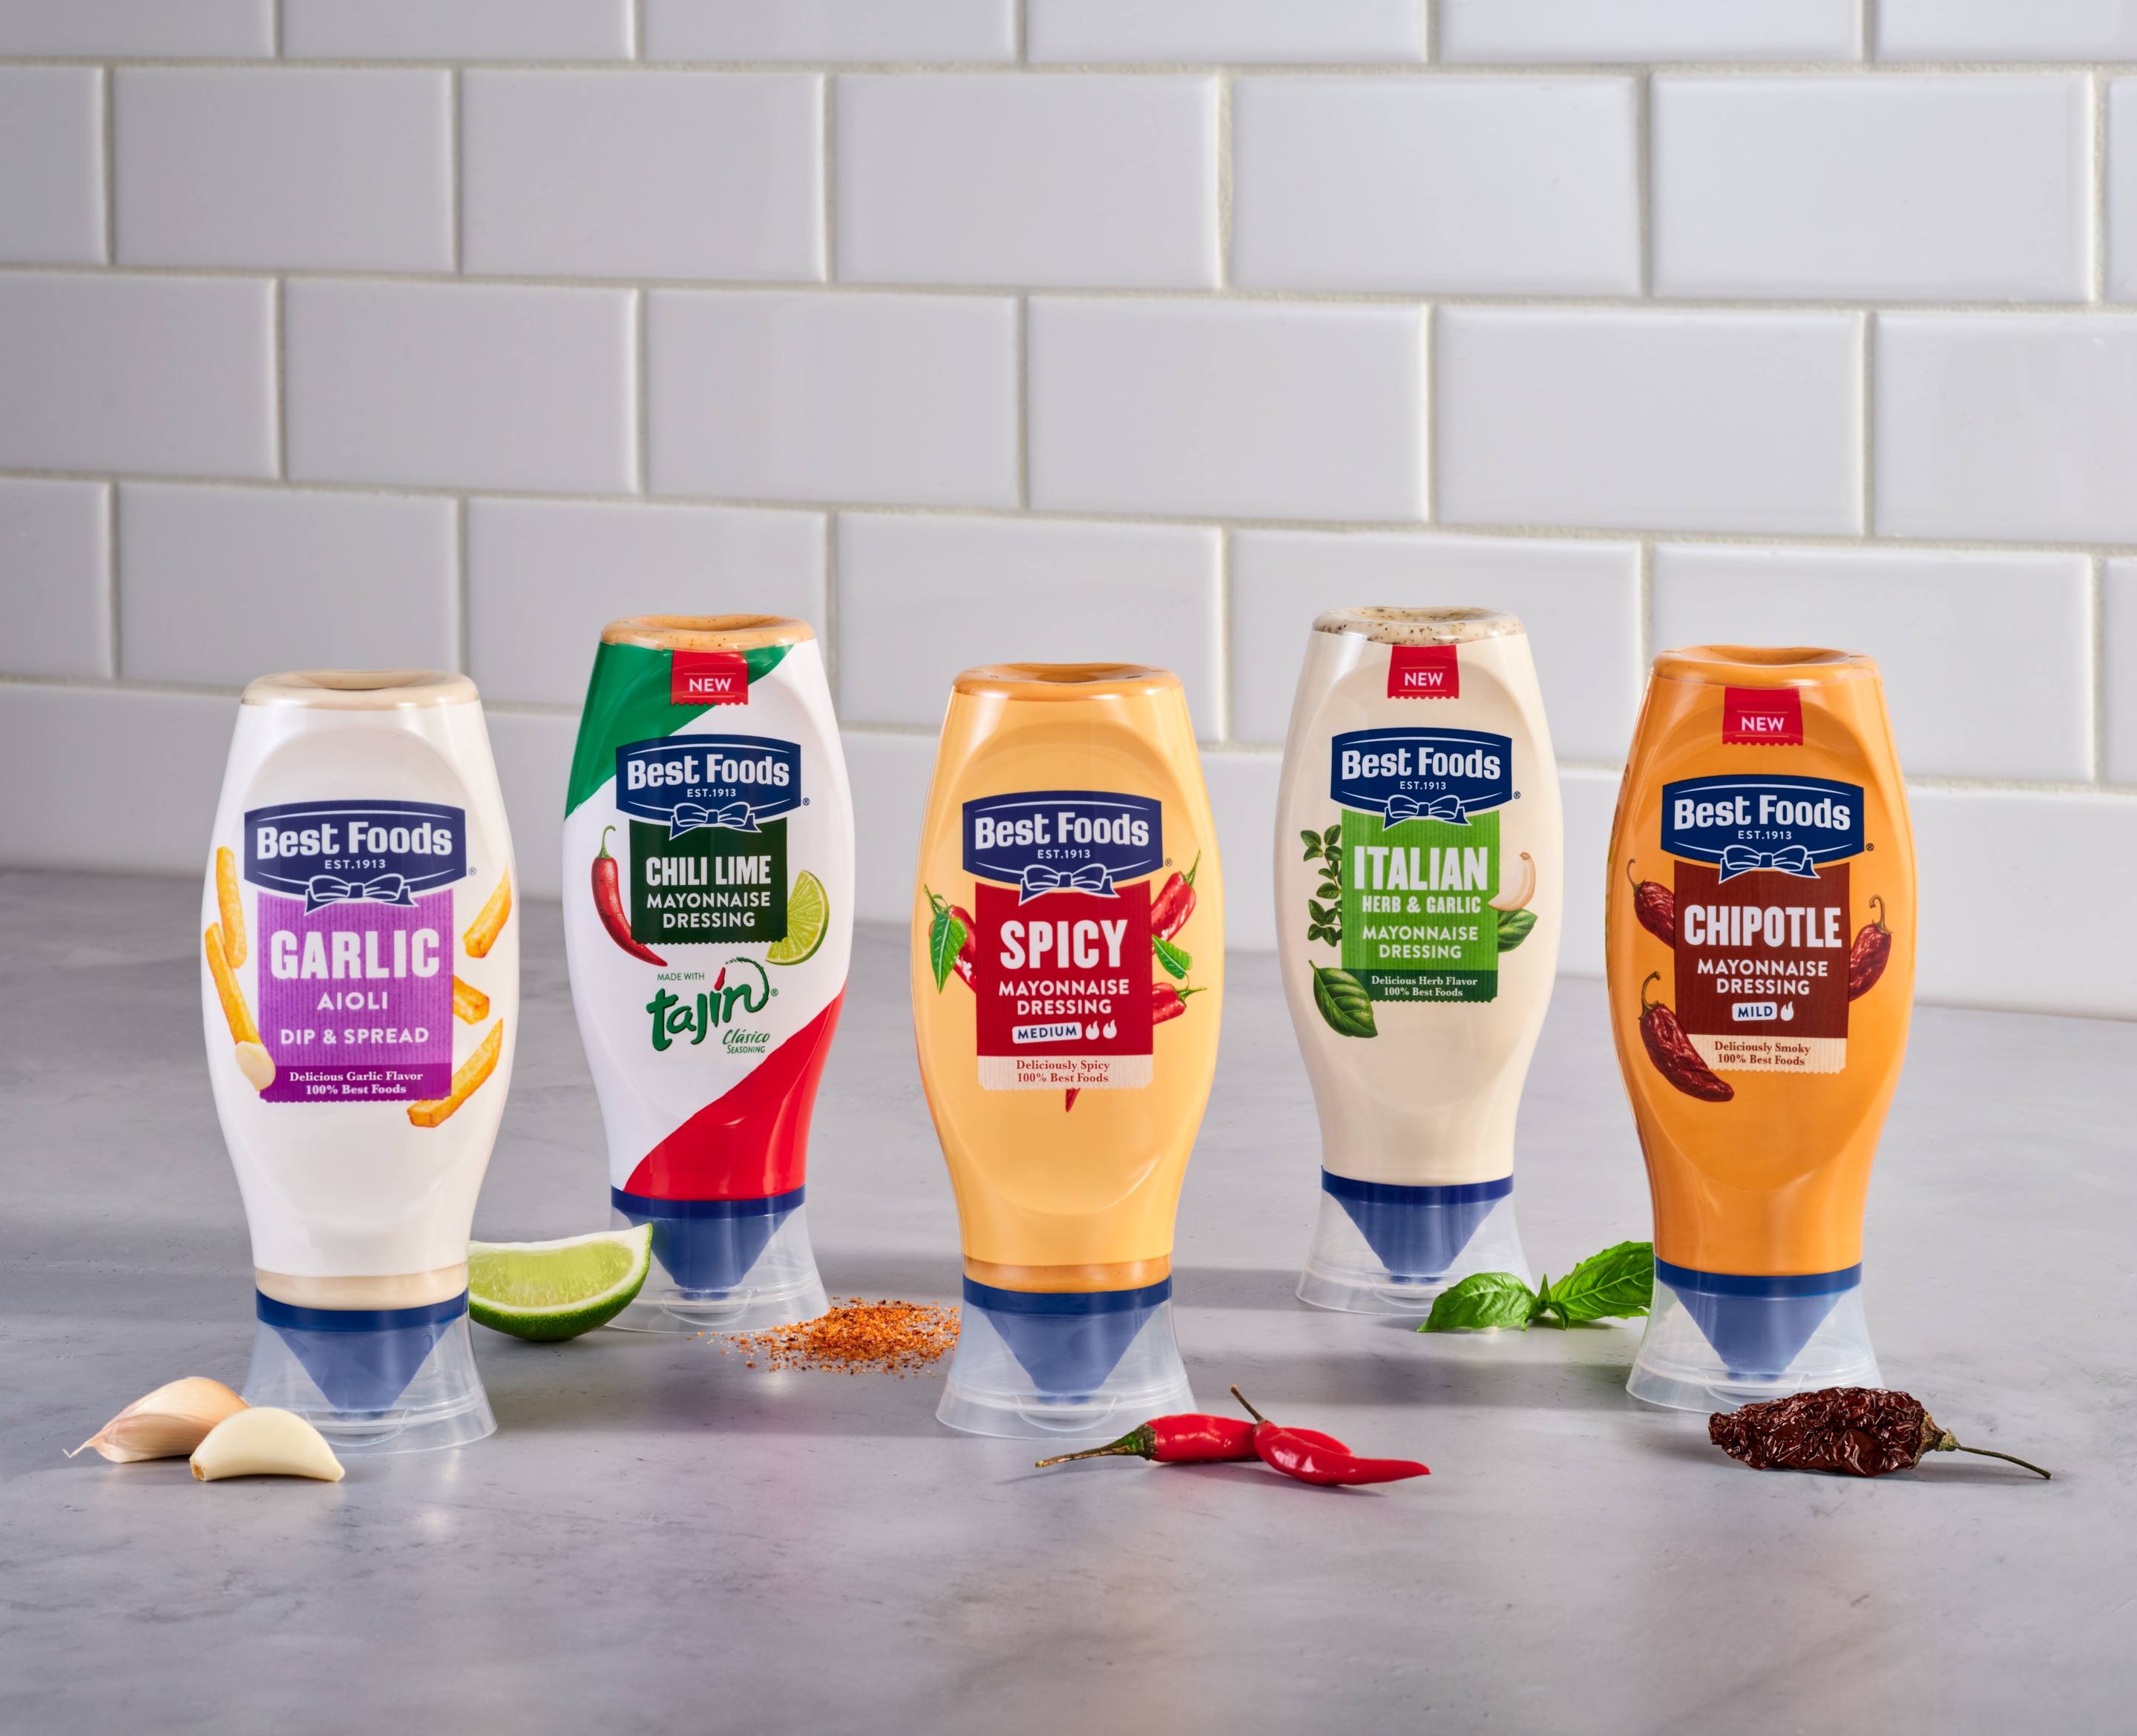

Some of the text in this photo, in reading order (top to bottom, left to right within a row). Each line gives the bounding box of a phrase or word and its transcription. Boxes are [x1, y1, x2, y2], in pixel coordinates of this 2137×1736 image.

[689, 678, 731, 691] NEW
[1405, 672, 1442, 686] NEW
[1742, 717, 1784, 731] NEW
[1342, 747, 1500, 780] Best Foods
[628, 754, 790, 790] Best Foods
[1675, 795, 1850, 830] Best Foods
[975, 812, 1149, 849] Best Foods
[257, 822, 452, 859] Best Foods
[646, 856, 771, 886] CHILI LIME
[1355, 846, 1487, 890] ITALIAN
[647, 892, 770, 908] MAYONNAISE
[1362, 895, 1480, 913] HERB & GARLIC
[663, 912, 755, 928] DRESSING
[1684, 904, 1842, 947] CHIPOTLE
[1363, 926, 1478, 941] MAYONNAISE
[1000, 920, 1128, 970] SPICY
[1379, 945, 1461, 958] DRESSING
[271, 929, 439, 979] GARLIC
[1698, 959, 1828, 976] MAYONNAISE
[999, 979, 1129, 996] MAYONNAISE
[1371, 976, 1477, 986] Delicious Herb Flavor
[1717, 979, 1809, 995] DRESSING
[1385, 987, 1463, 996] 100% Best Foods
[317, 992, 387, 1010] AIOLI
[1017, 999, 1112, 1015] DRESSING
[1738, 1006, 1773, 1018] MILD
[281, 1028, 429, 1045] DIP & SPREAD
[723, 1028, 770, 1045] Clásico
[1018, 1025, 1077, 1039] MEDIUM
[1715, 1042, 1811, 1055] Deliciously Smoky
[1017, 1060, 1110, 1072] Deliciously Spicy
[1718, 1054, 1805, 1065] 100% Best Foods
[289, 1071, 423, 1081] Delicious Garlic Flavor
[1018, 1073, 1108, 1082] 100% Best Foods
[306, 1084, 407, 1094] 100% Best Foods
